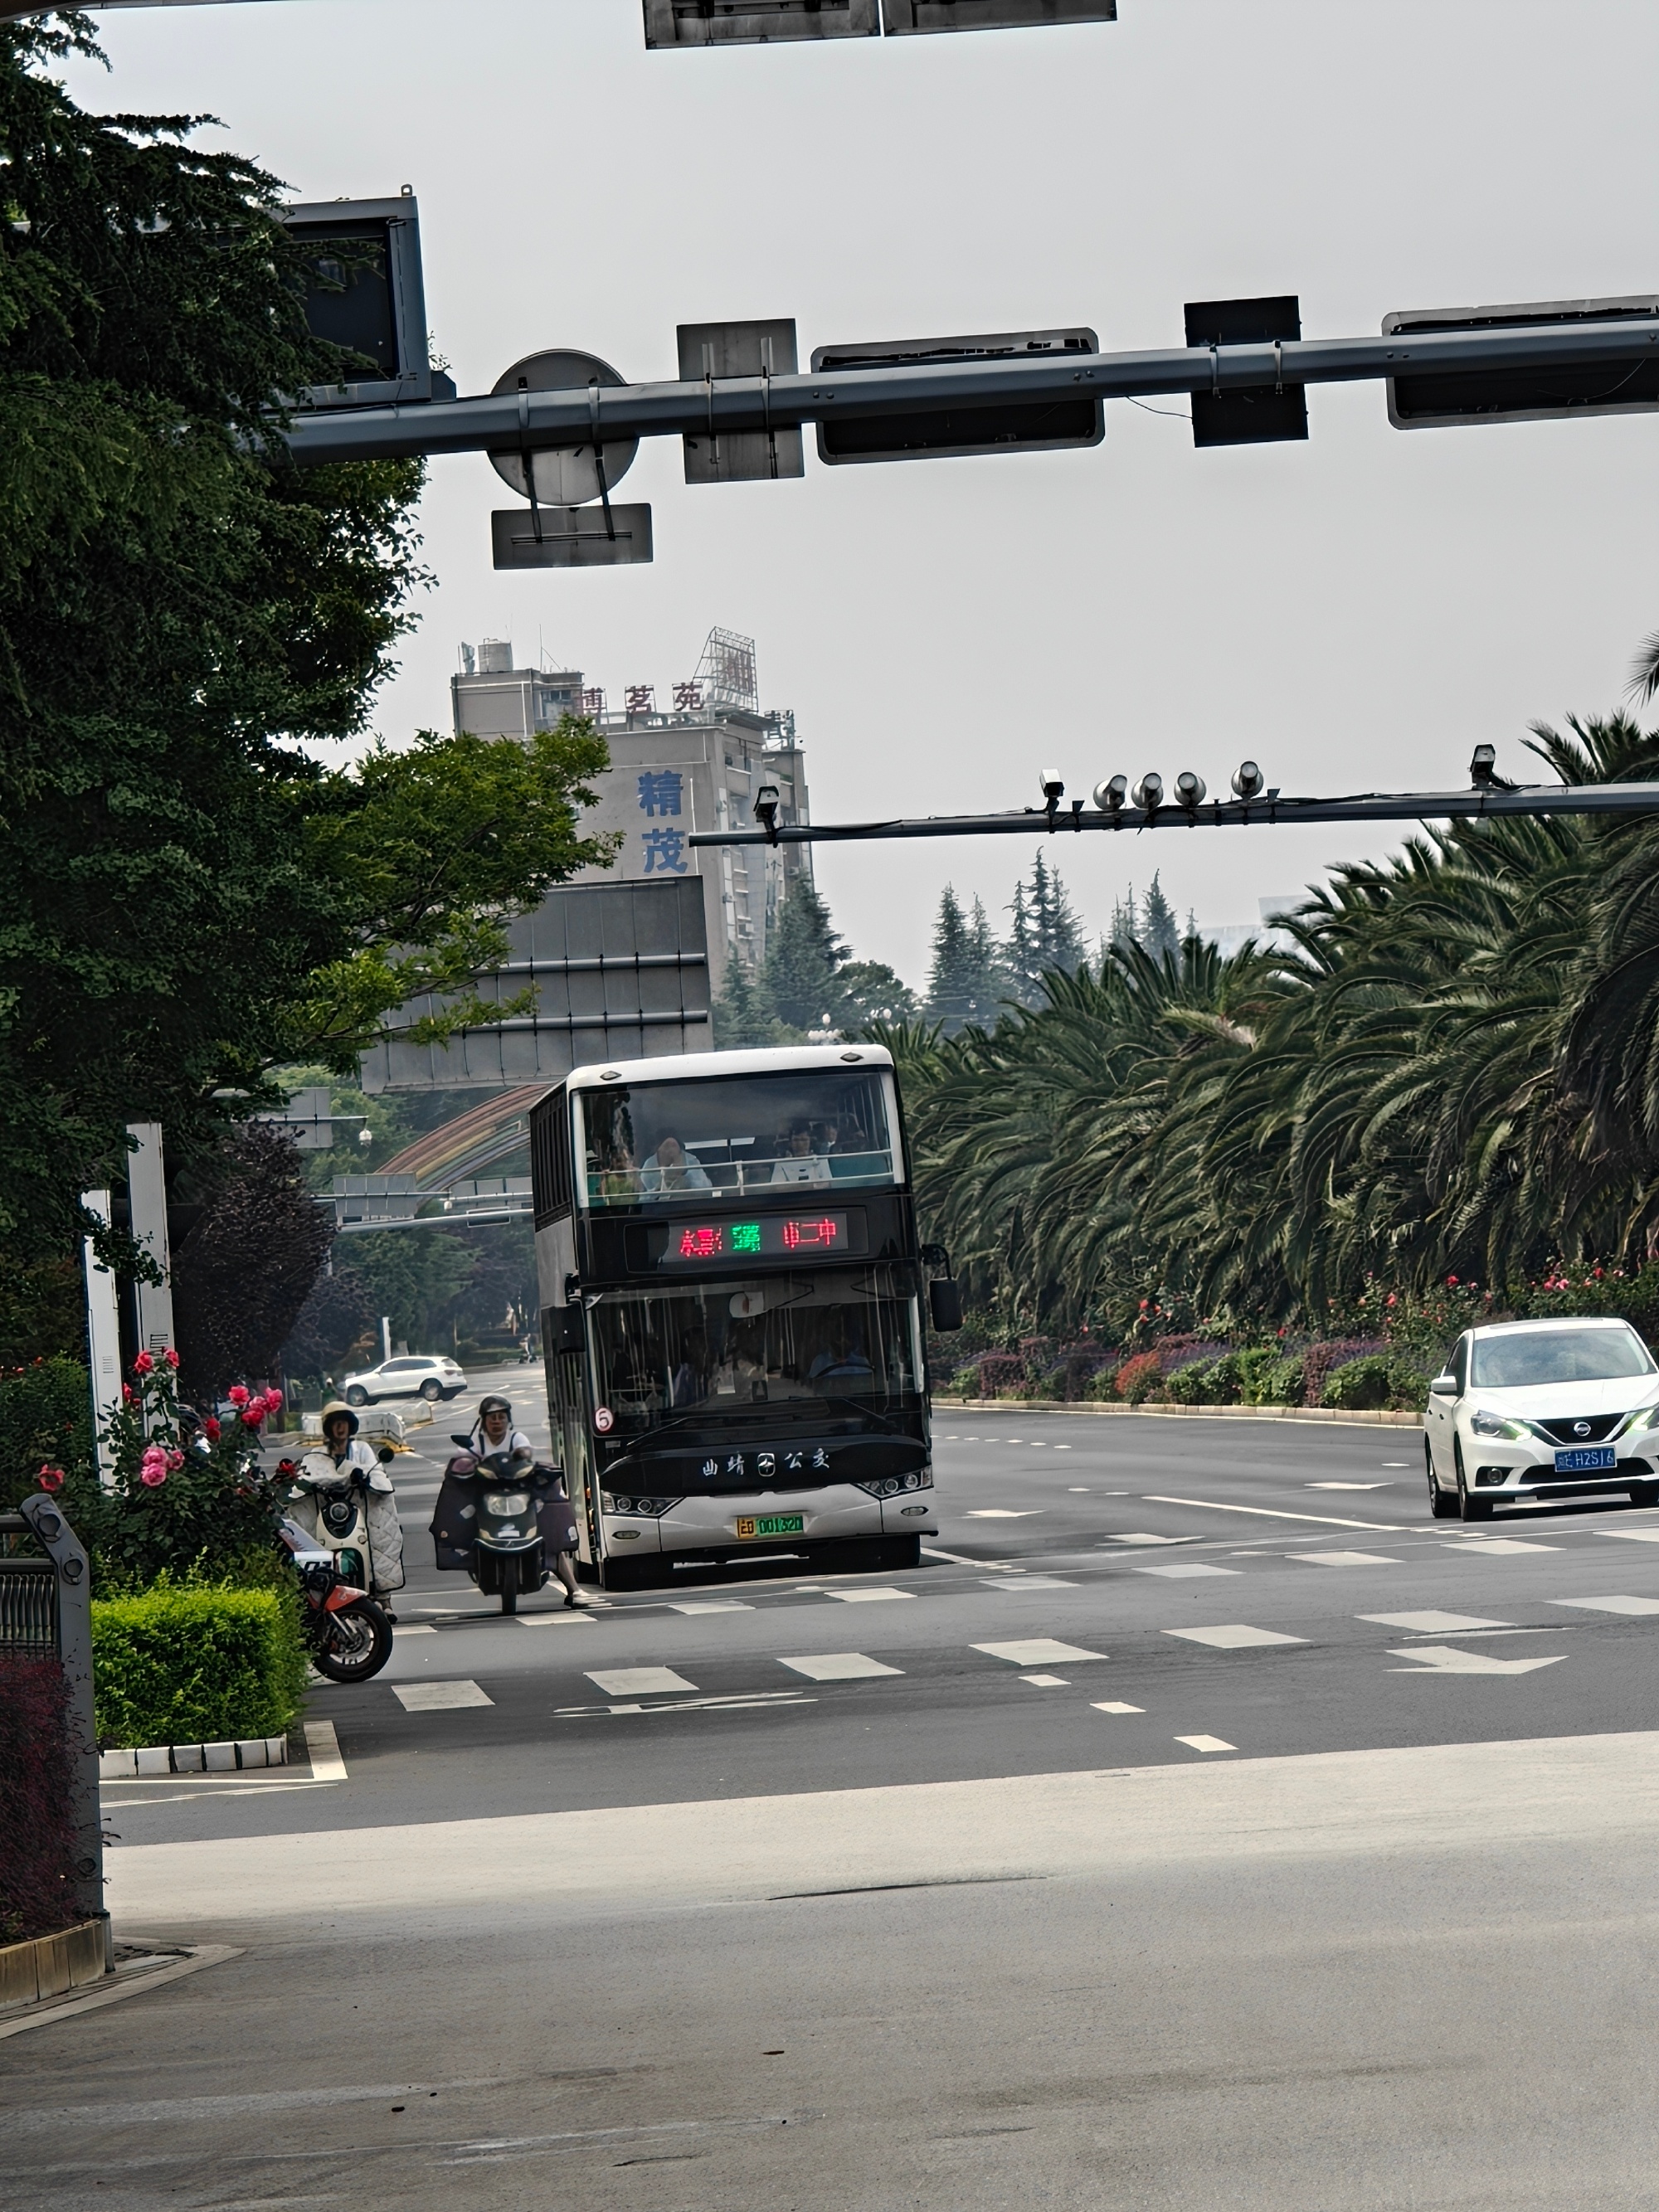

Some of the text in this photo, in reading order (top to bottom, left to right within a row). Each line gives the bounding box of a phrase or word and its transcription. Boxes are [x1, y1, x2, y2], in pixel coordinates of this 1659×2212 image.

[638, 770, 688, 873] 精茂
[599, 1410, 610, 1428] 5
[784, 1447, 830, 1469] 公交
